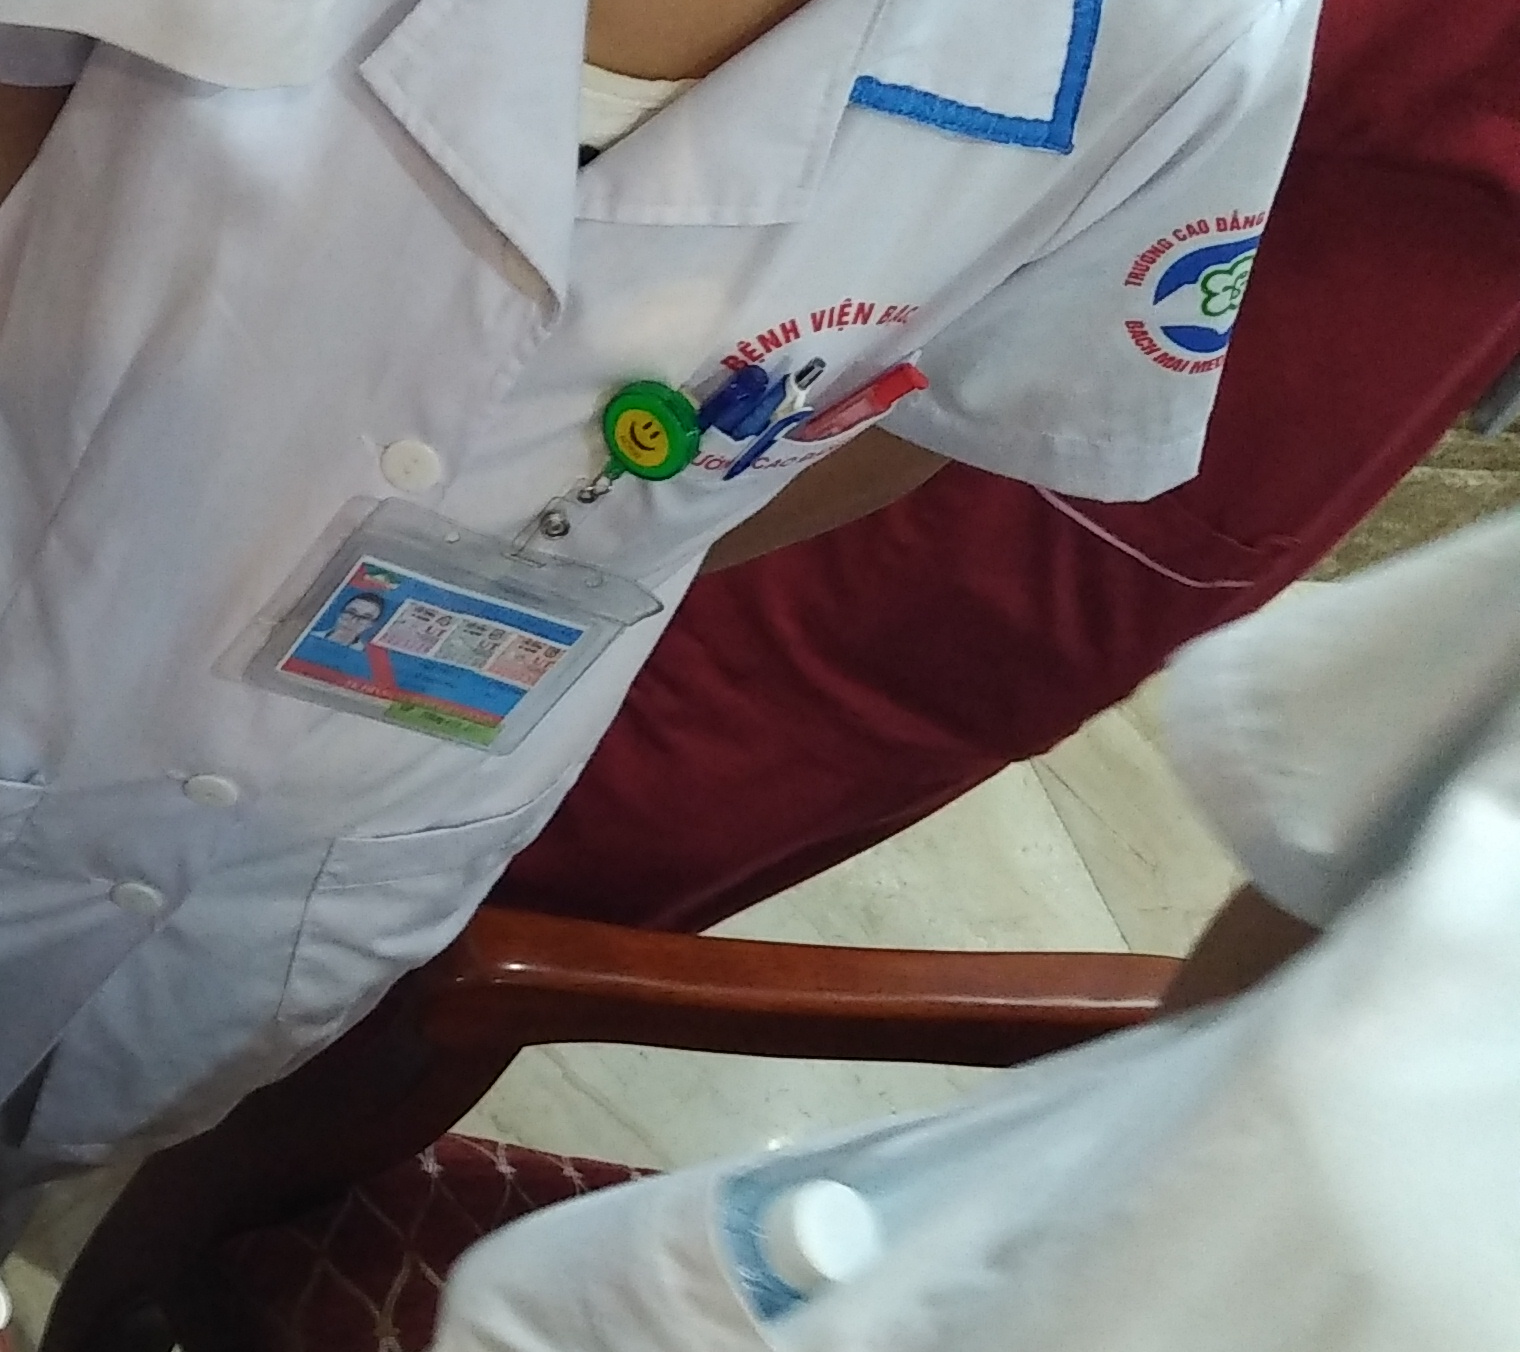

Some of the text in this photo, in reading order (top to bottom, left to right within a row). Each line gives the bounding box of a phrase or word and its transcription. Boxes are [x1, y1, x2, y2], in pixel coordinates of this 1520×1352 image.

[1172, 219, 1210, 242] CAO
[720, 318, 801, 371] BỆNH
[810, 298, 876, 333] VIỆN
[1152, 352, 1191, 373] MAI
